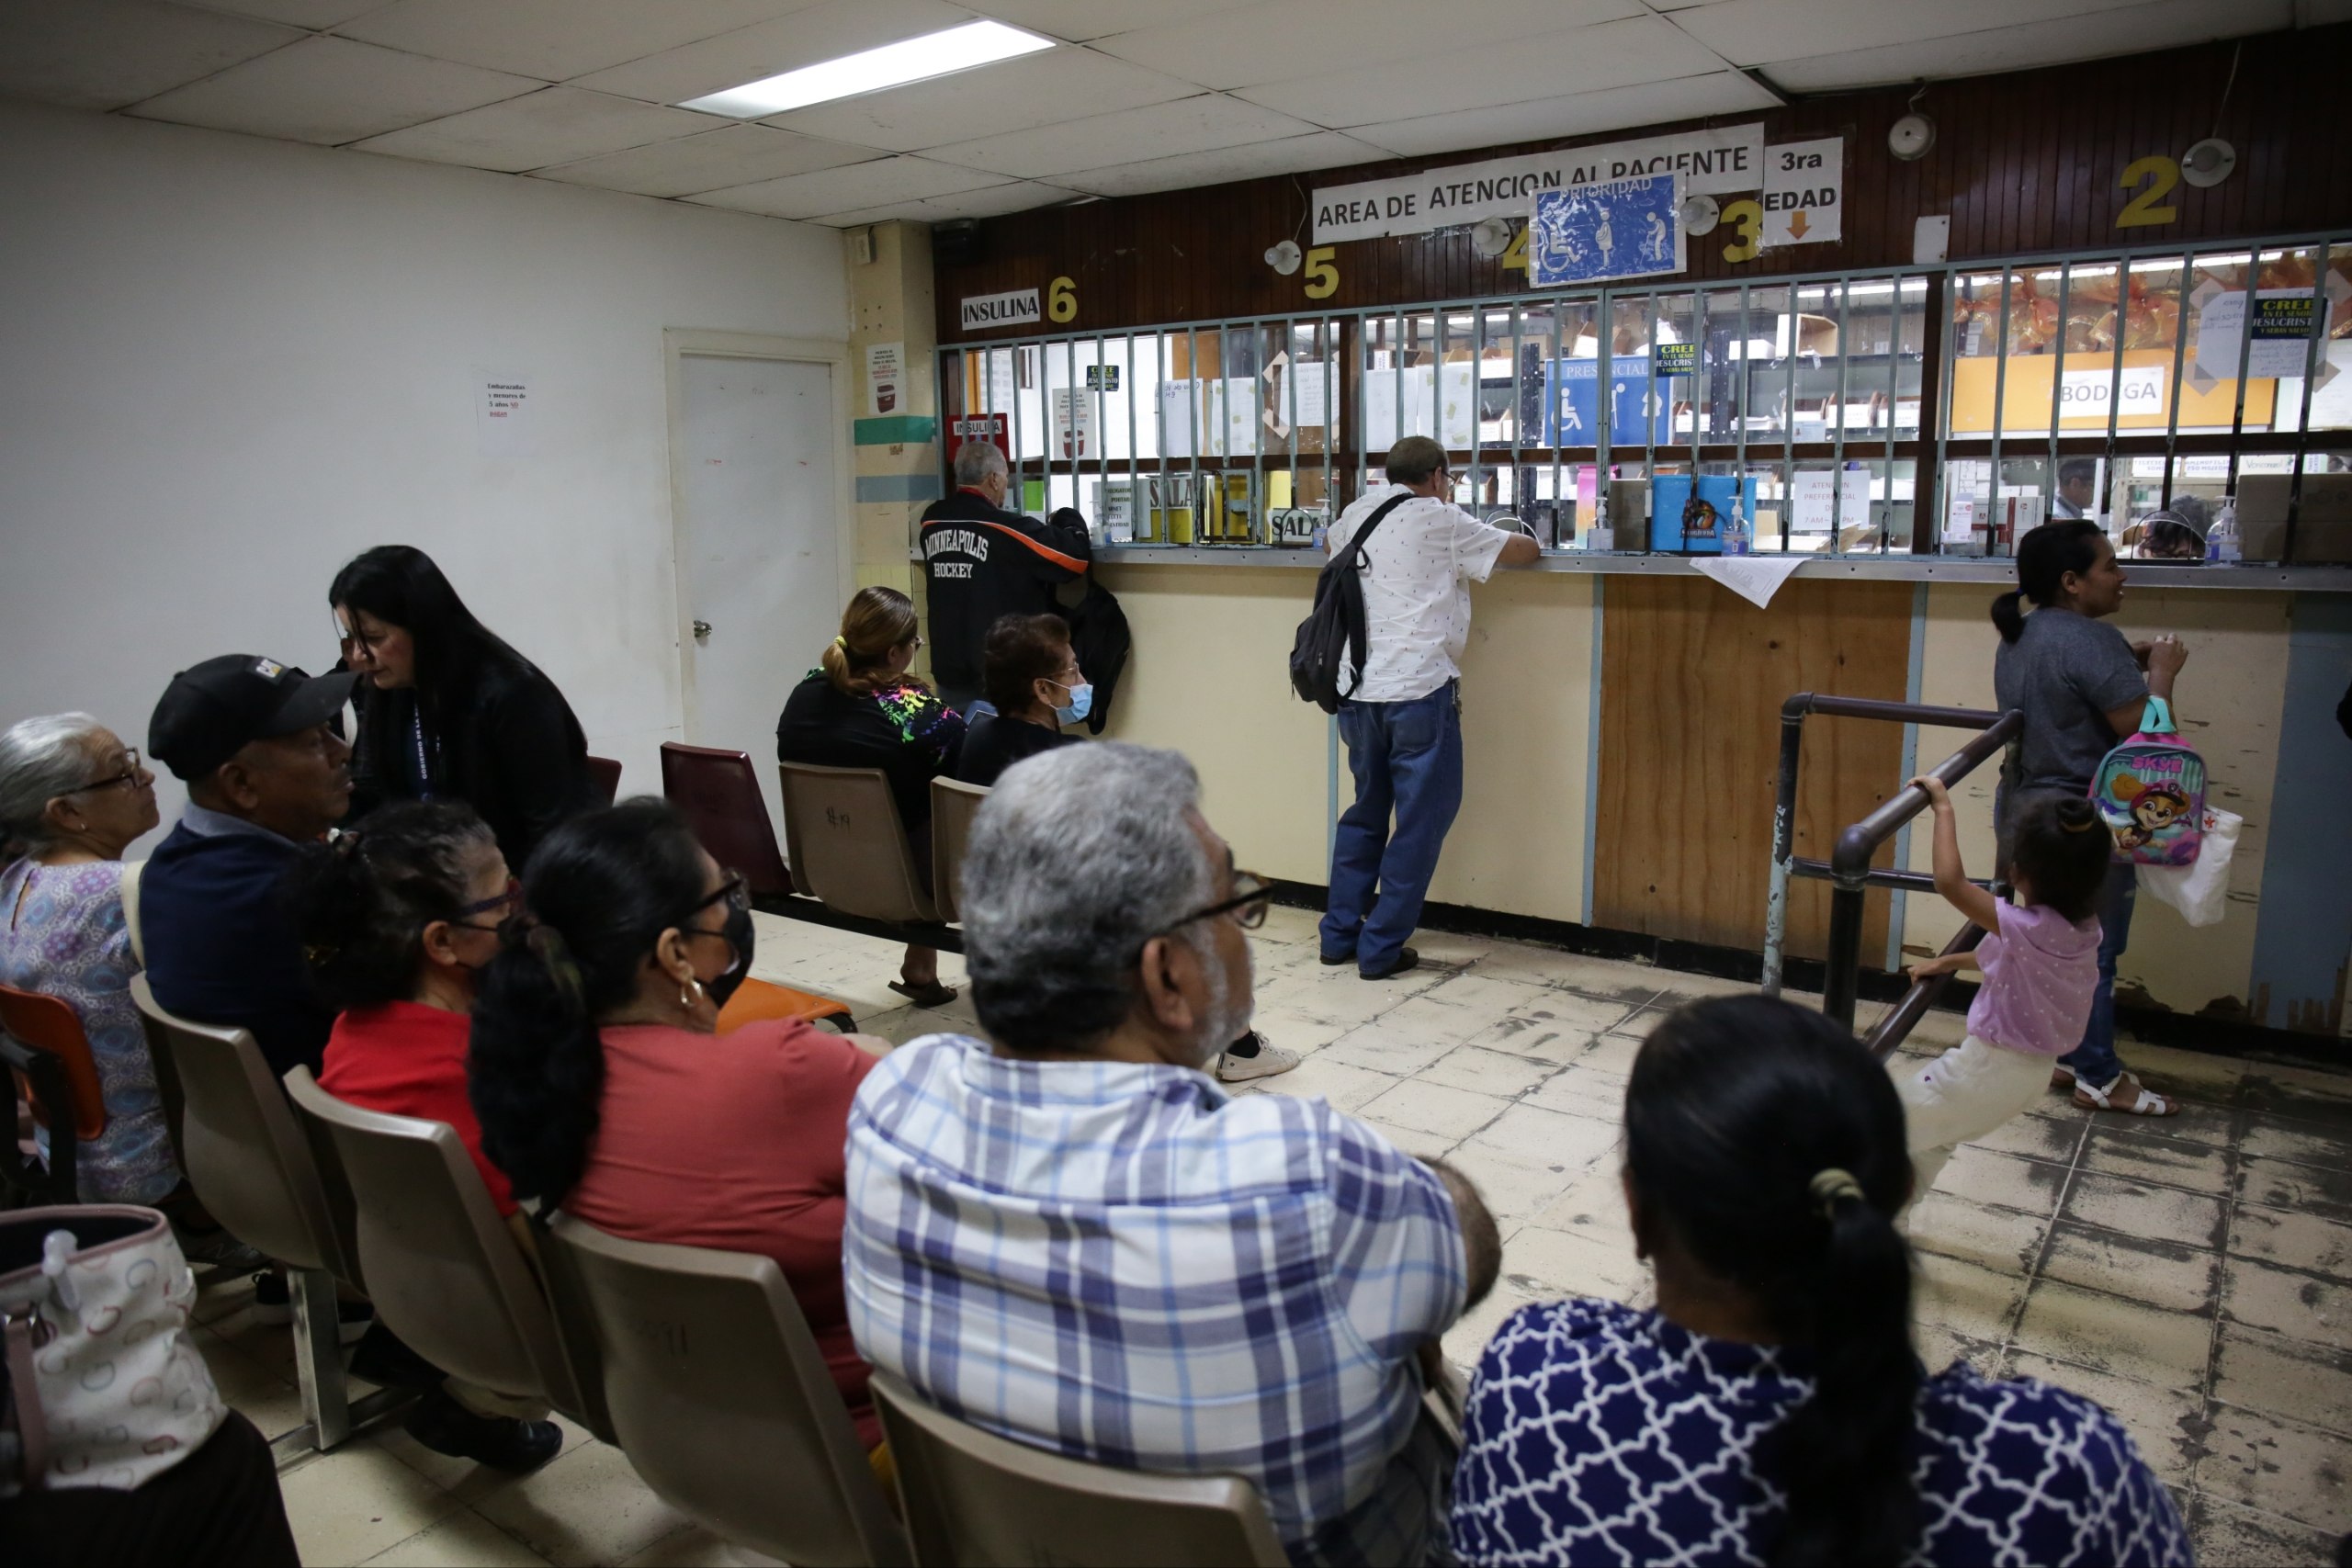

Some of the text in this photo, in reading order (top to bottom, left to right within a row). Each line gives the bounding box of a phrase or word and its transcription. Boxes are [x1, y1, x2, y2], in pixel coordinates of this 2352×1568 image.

[1781, 152, 1823, 172] 3ra
[1317, 199, 1380, 228] AREA
[1386, 194, 1417, 219] DE
[1429, 170, 1561, 209] ATENCION
[1611, 146, 1748, 180] PACIENTE
[1562, 178, 1653, 199] PRIORIDAD
[2115, 155, 2178, 229] 2
[1764, 187, 1837, 212] EDAD
[1719, 199, 1763, 264] 3
[1304, 246, 1340, 299] 5
[963, 296, 1039, 323] INSULINA
[1048, 276, 1078, 323] 6
[2253, 318, 2312, 327] JESUCRIST
[1566, 364, 1648, 378] PRESNCIAL
[1656, 359, 1695, 367] JESUCRIST
[2061, 382, 2157, 402] BODGA
[956, 422, 1001, 433] INSULIA
[1811, 481, 1849, 490] ATENCN
[924, 529, 989, 562] MINNEAPOLIS
[933, 561, 974, 579] HOCKEY
[2131, 755, 2184, 773] SKYE
